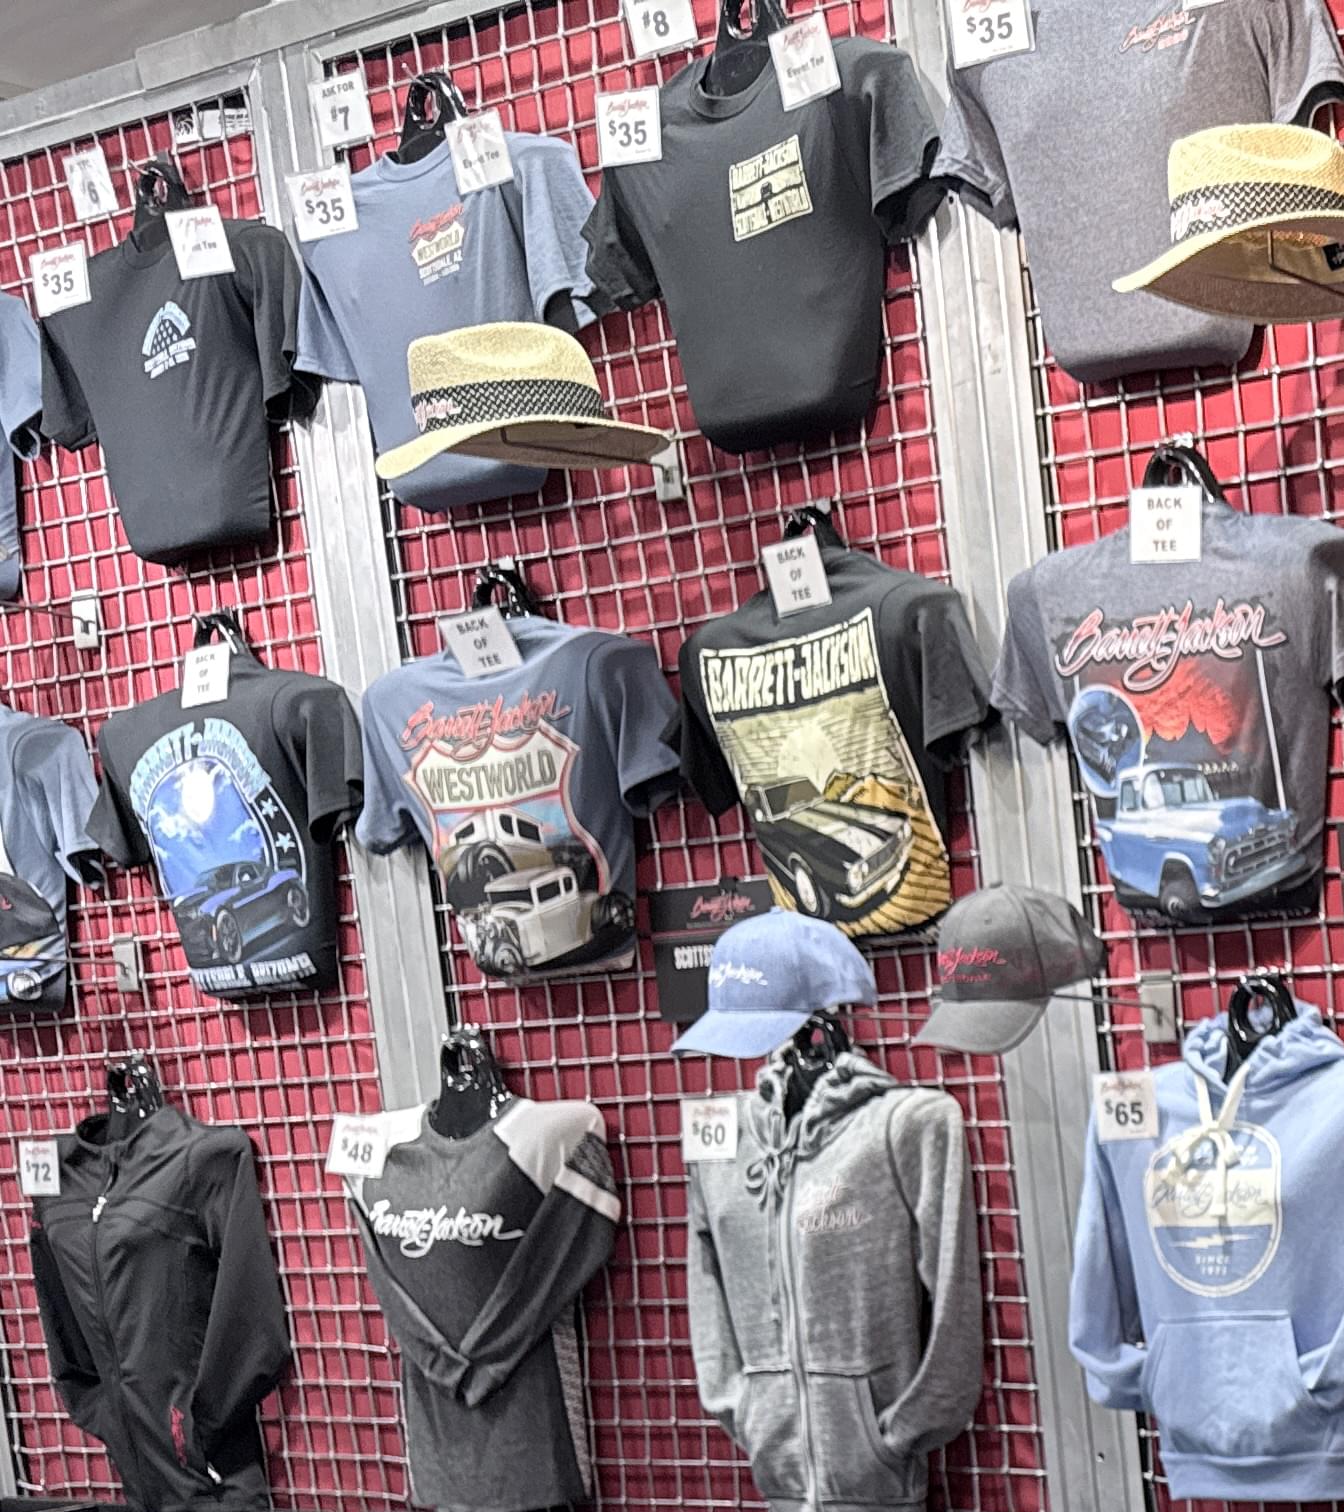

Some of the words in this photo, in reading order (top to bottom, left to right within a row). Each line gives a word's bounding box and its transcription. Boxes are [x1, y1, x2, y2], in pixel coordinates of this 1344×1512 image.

[642, 10, 670, 37] #8
[966, 12, 1013, 44] $35
[337, 81, 354, 94] FOR
[331, 105, 349, 131] #7
[608, 120, 647, 147] $35
[305, 198, 344, 224] $35
[42, 270, 74, 295] $35
[1147, 497, 1182, 510] BACK
[1156, 519, 1173, 531] OF
[1152, 540, 1177, 552] TEE
[456, 618, 489, 635] BACK
[473, 638, 489, 650] OF
[1054, 597, 1287, 693] Barrett-Jackson
[479, 654, 500, 669] TEE
[707, 619, 876, 714] BARRETT-JACKSON
[422, 749, 557, 804] WESTWORLD
[674, 944, 713, 970] SCOTTS
[1105, 1100, 1144, 1126] $65
[692, 1122, 726, 1146] $60
[341, 1137, 373, 1164] $48
[26, 1160, 51, 1182] $72
